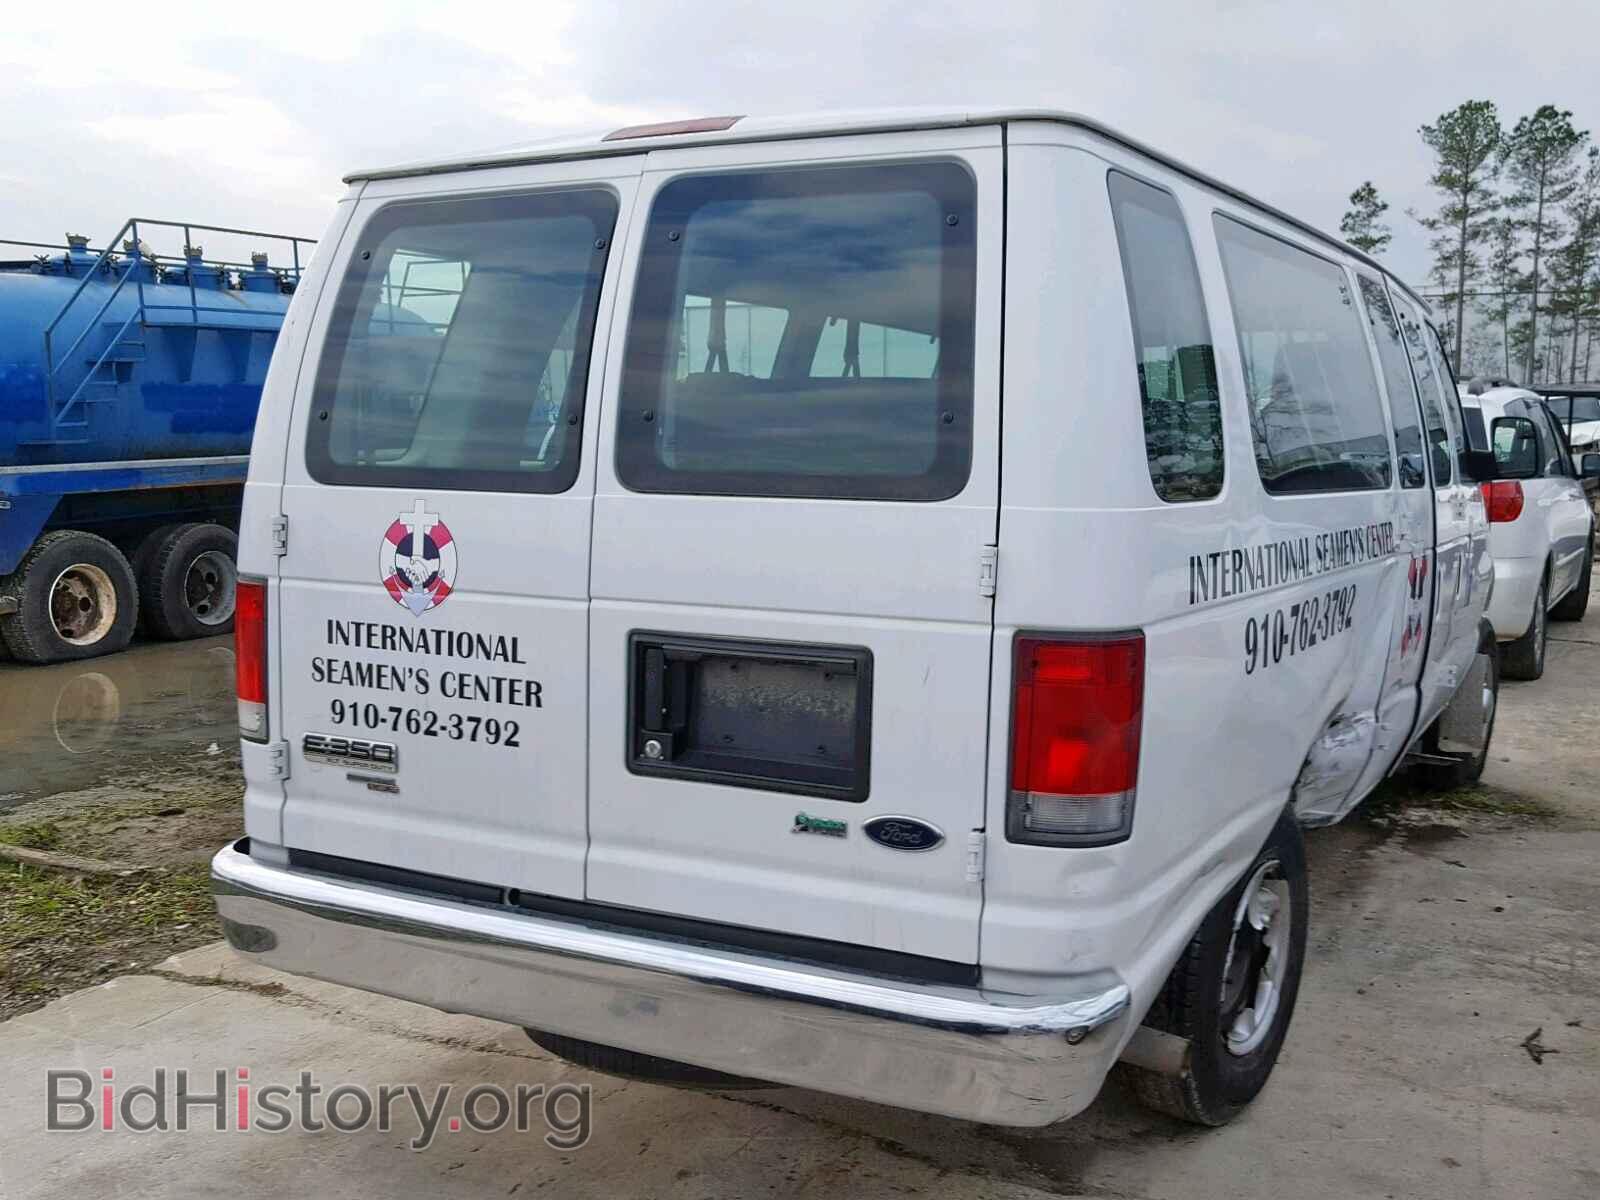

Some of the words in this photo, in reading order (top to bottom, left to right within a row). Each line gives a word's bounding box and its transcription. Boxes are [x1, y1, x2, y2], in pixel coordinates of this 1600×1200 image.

[1188, 536, 1312, 605] INTERNATIONAL
[1315, 526, 1365, 575] SEAMEN'S
[1366, 521, 1394, 561] CENTER
[326, 618, 528, 665] INTERNATIONAL
[1245, 583, 1357, 675] 910-762-3792
[311, 656, 430, 696] SEAMEN'S
[439, 670, 543, 708] CENTER
[330, 698, 520, 748] 910-762-3792
[879, 821, 924, 844] Ford
